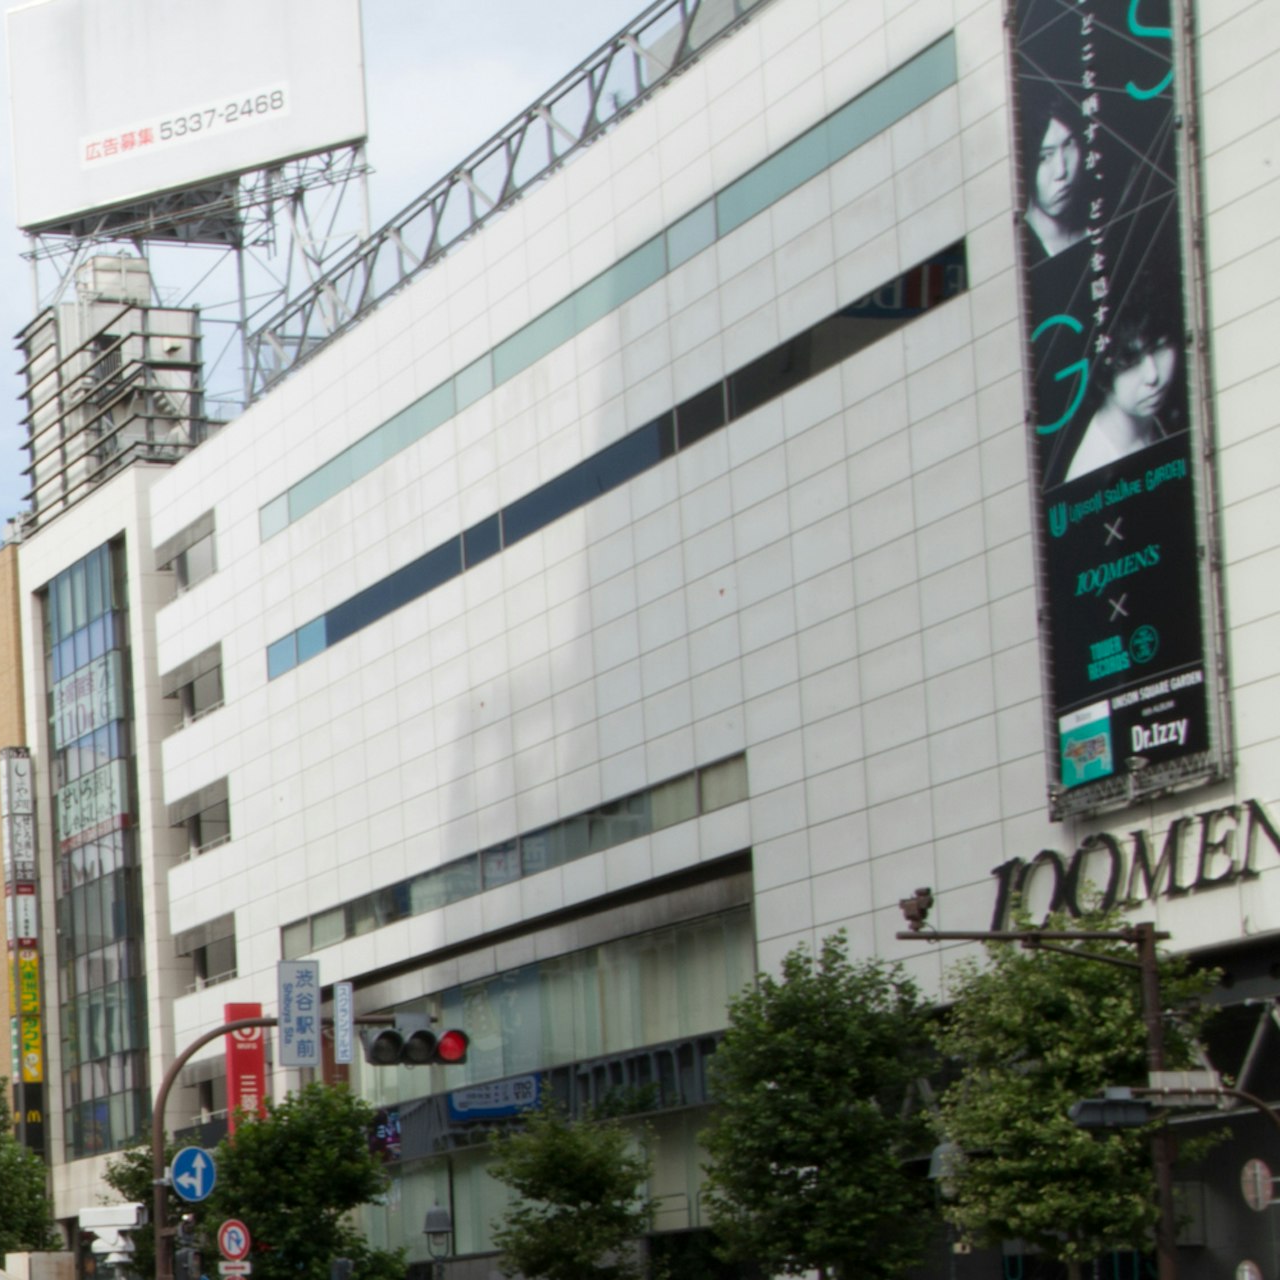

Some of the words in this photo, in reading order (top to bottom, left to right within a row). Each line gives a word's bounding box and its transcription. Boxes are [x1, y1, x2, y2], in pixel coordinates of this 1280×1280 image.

[85, 127, 154, 161] 広告募集
[159, 90, 285, 141] 5337-2468
[1144, 458, 1186, 492] GARDEN
[1090, 635, 1122, 661] TOWER
[1088, 651, 1131, 682] RECORDS
[1140, 679, 1170, 700] SQUARE
[1170, 670, 1203, 691] GARDEN
[1131, 718, 1189, 752] Dr.Izzy
[295, 969, 315, 1058] 渋谷駅前
